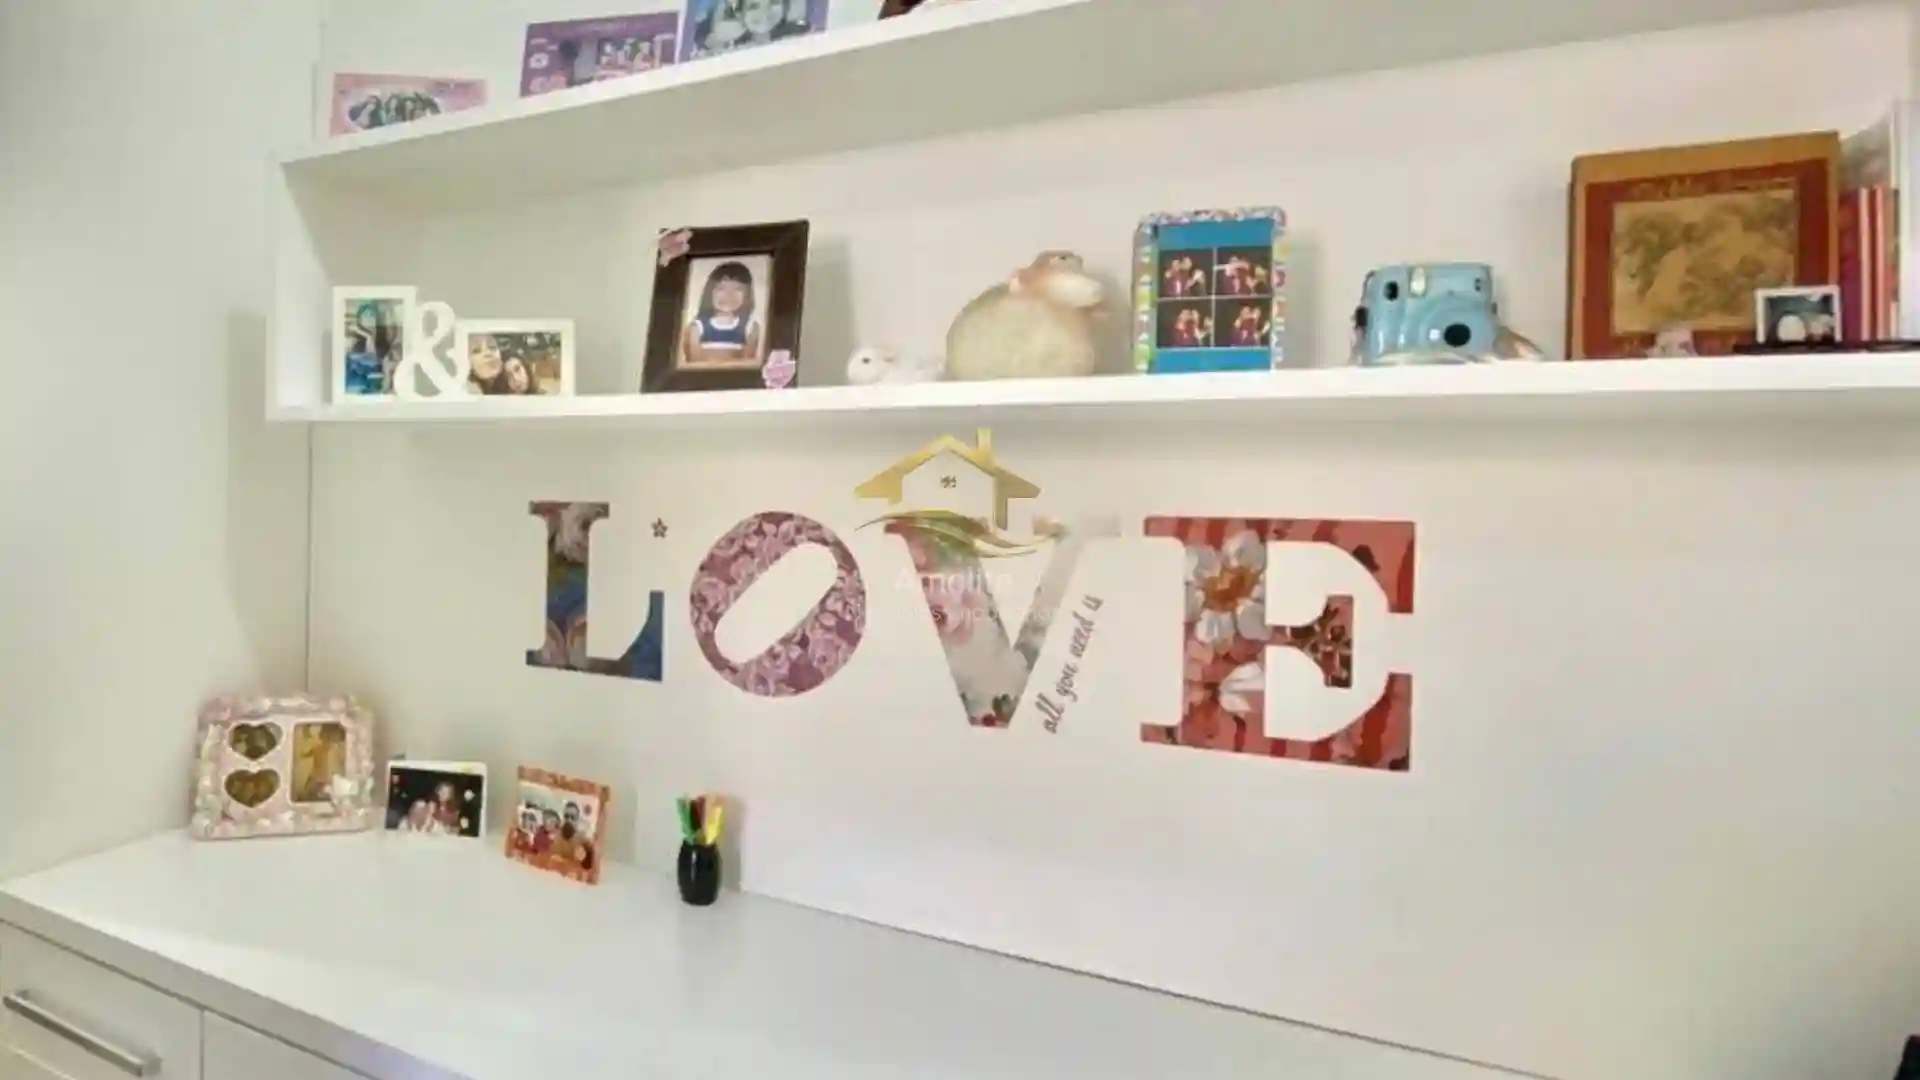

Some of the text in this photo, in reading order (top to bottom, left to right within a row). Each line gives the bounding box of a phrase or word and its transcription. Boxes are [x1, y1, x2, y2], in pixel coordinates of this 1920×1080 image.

[394, 301, 457, 400] &
[526, 500, 1418, 772] LOVE
[1034, 594, 1104, 734] all you need is
